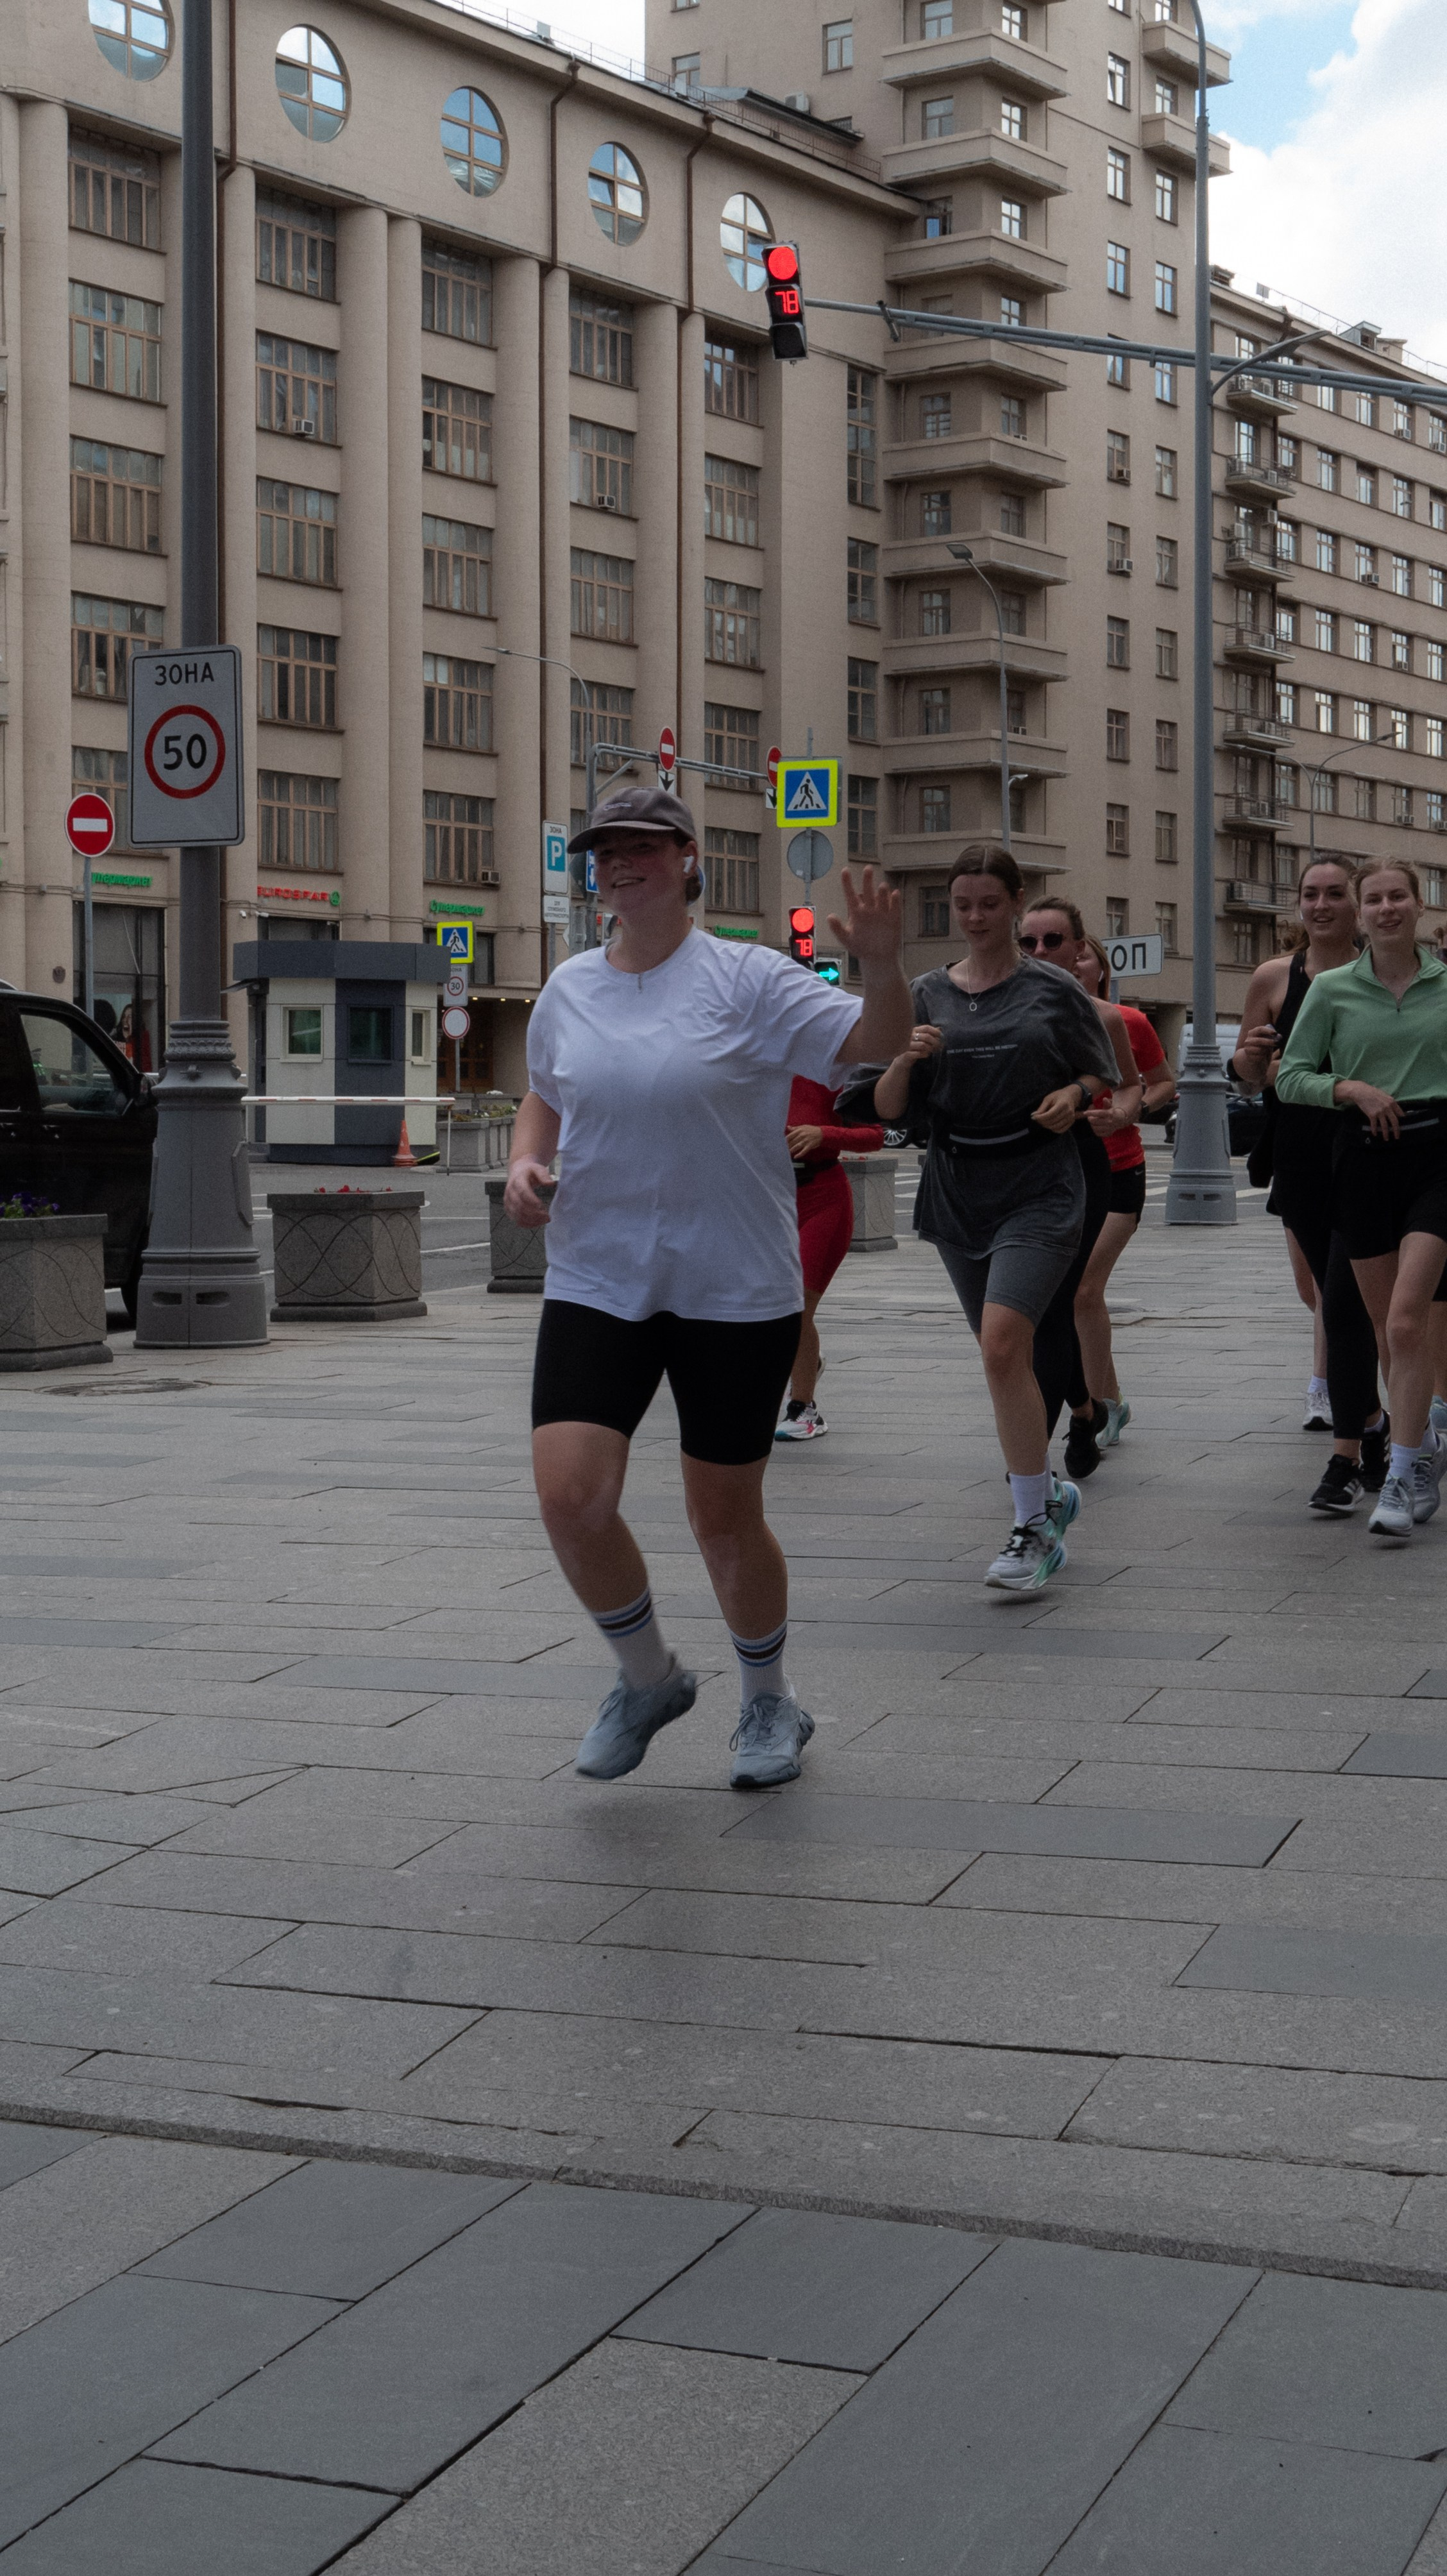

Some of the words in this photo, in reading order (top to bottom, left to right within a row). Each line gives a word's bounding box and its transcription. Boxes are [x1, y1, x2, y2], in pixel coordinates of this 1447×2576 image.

[775, 290, 799, 314] 78
[154, 661, 215, 686] ЗОНА
[163, 733, 207, 770] 50
[91, 872, 153, 887] упермаркет
[257, 885, 329, 901] EUROSPAR
[795, 938, 813, 956] 78
[1103, 942, 1146, 971] ОП
[451, 982, 461, 990] 30
